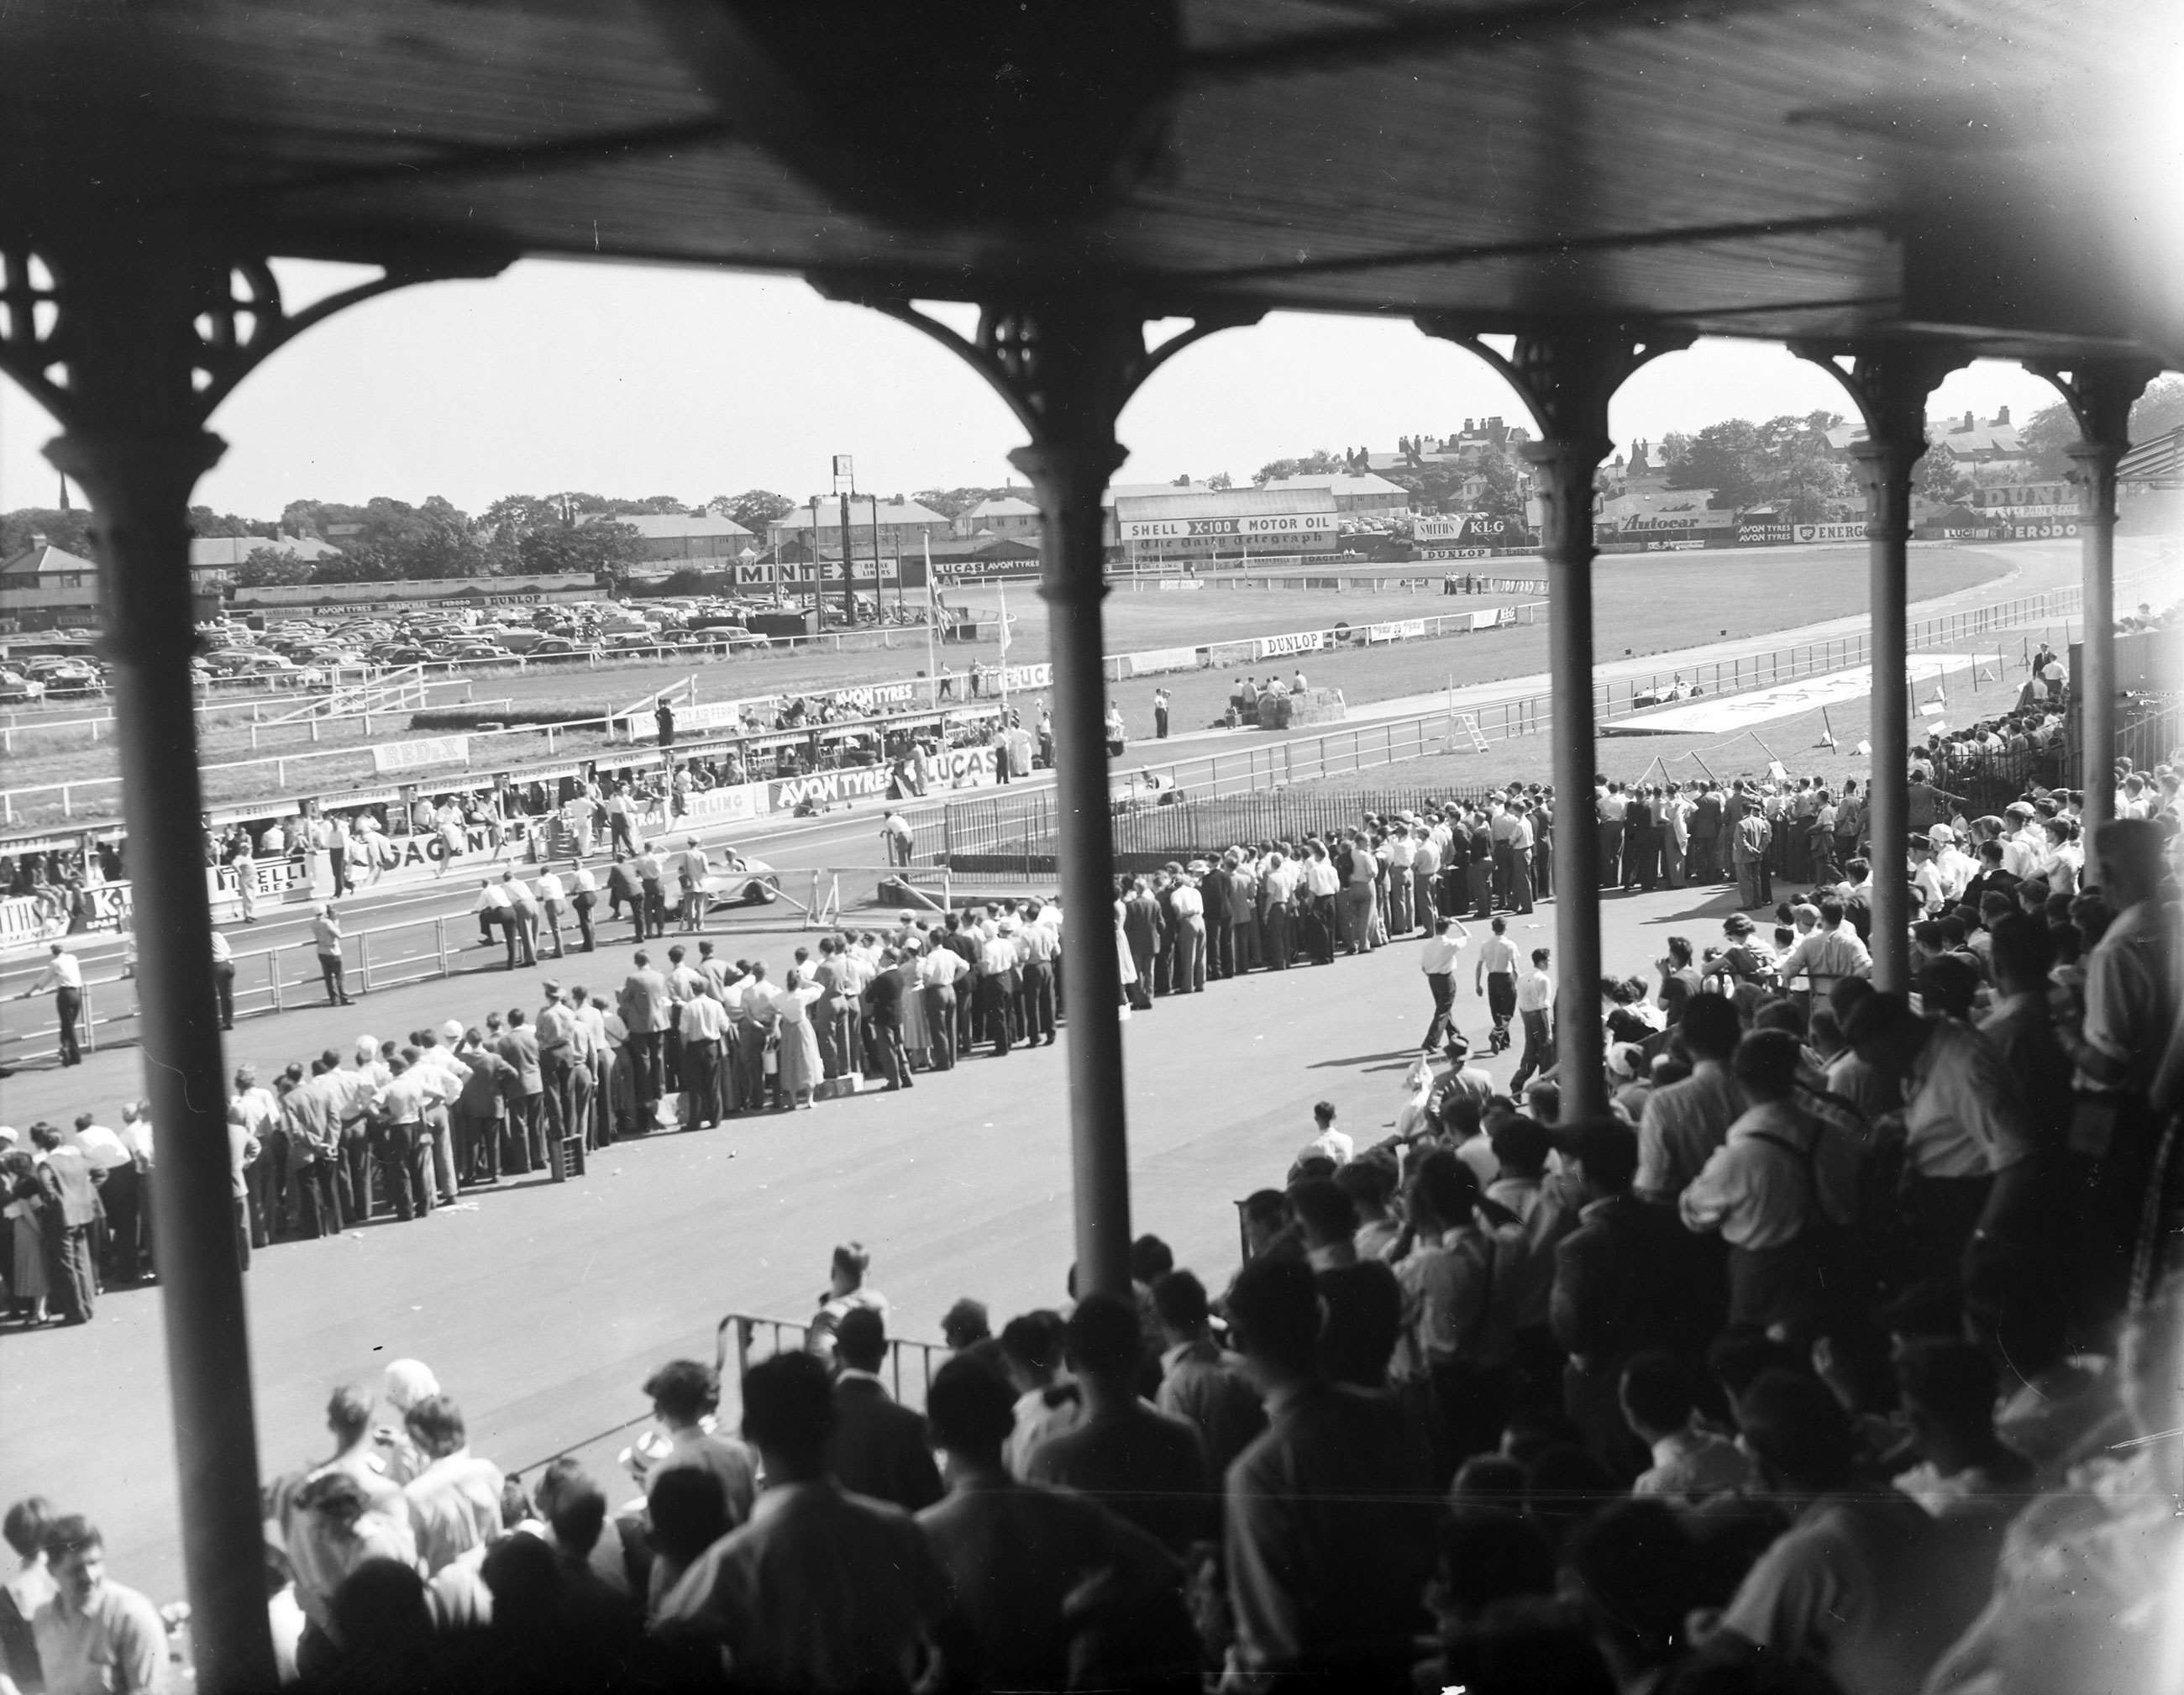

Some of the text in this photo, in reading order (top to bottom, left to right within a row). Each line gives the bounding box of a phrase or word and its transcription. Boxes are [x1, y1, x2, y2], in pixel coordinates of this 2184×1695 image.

[1984, 488, 2079, 506] DUNL
[1132, 517, 1330, 536] SHELL X-100 MOTOR OIL
[1620, 513, 1698, 530] Autocar
[1420, 522, 1455, 535] SMITHS
[1739, 524, 1765, 533] AVON
[1234, 532, 1323, 545] Telegraph
[1739, 533, 1765, 543] AVON
[1428, 548, 1486, 559] DUNLOP
[934, 563, 982, 573] LUCAS
[987, 559, 1040, 570] AVON TYRES
[740, 563, 857, 583] MINTEX
[442, 599, 471, 608] FERODO
[490, 594, 541, 606] DUNLOP
[318, 604, 372, 616] AVON TYRES
[1268, 632, 1318, 653] DUNLOP
[834, 684, 913, 711] AVON TYRES
[927, 751, 997, 783] LUCAS
[776, 764, 894, 809] AVON TYRES
